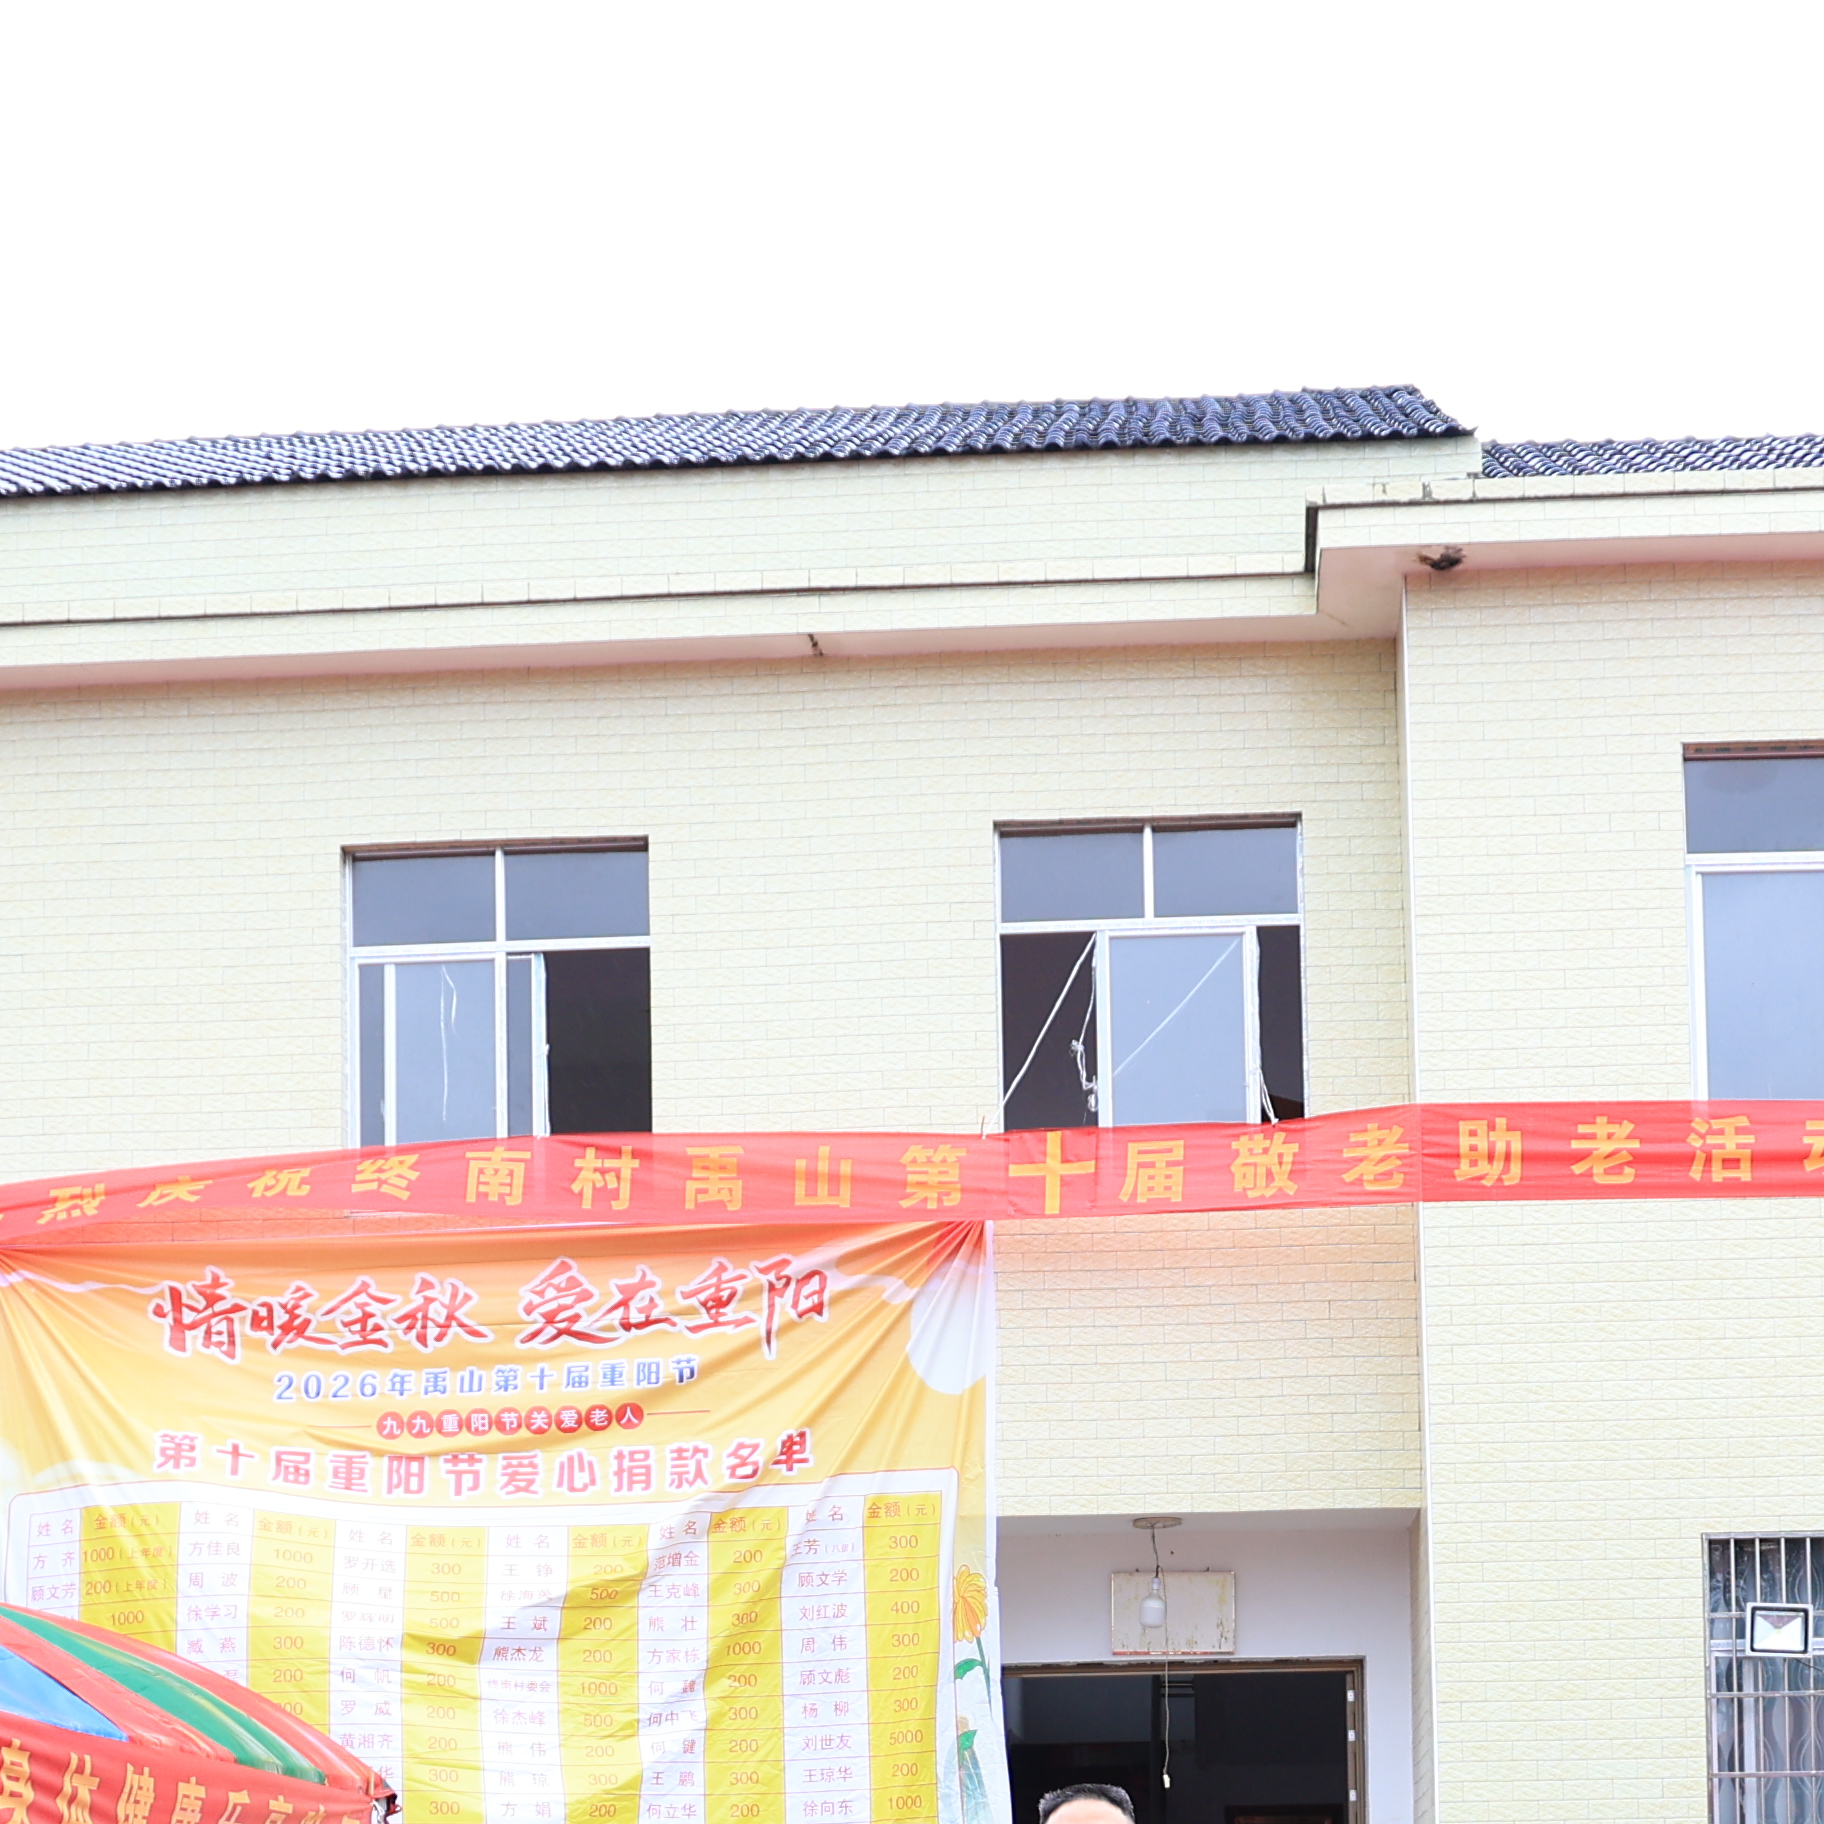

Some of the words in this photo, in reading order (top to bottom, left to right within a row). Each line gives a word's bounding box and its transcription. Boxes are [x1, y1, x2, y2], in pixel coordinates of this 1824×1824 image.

[152, 1272, 486, 1358] 情暖金秋
[519, 1259, 829, 1358] 爱在重阳
[276, 1356, 698, 1400] 2026年禹山第十届重阳节
[379, 1404, 642, 1438] 九九重阳节关爱老人
[155, 1430, 810, 1496] 第十届重阳节爱心捐款名单
[188, 1540, 240, 1557] 方佳良
[889, 1535, 918, 1549] 300
[273, 1548, 313, 1563] 1000
[733, 1550, 763, 1564] 200
[431, 1563, 461, 1575] 300
[594, 1564, 623, 1575] 200
[889, 1568, 919, 1582] 200
[275, 1576, 306, 1589] 200
[798, 1569, 847, 1587] 顾文学
[31, 1582, 76, 1602] 顾文芳
[590, 1588, 618, 1602] 500
[648, 1583, 700, 1599] 王克峰
[733, 1580, 761, 1595] 300
[430, 1591, 460, 1602] 500
[187, 1604, 237, 1622] 徐学习
[274, 1606, 305, 1618] 200
[799, 1602, 848, 1619] 刘红波
[890, 1600, 920, 1614] 400
[110, 1610, 145, 1626] 1000
[429, 1617, 459, 1629] 500
[582, 1617, 612, 1630] 200
[732, 1611, 758, 1625] 300
[273, 1636, 304, 1650] 300
[339, 1635, 395, 1652] 陈德怀
[892, 1633, 920, 1647] 300
[426, 1642, 457, 1656] 300
[583, 1649, 612, 1663] 200
[726, 1641, 761, 1656] 1000
[273, 1668, 304, 1683] 200
[427, 1672, 456, 1687] 200
[893, 1665, 918, 1680] 200
[726, 1674, 757, 1687] 200
[579, 1682, 618, 1697] 1000
[426, 1705, 456, 1720] 200
[894, 1697, 918, 1713] 300
[584, 1714, 613, 1728] 500
[728, 1706, 759, 1721] 300
[428, 1736, 458, 1752] 200
[802, 1733, 851, 1751] 刘世友
[889, 1729, 923, 1746] 5000
[585, 1745, 614, 1757] 200
[729, 1739, 758, 1753] 200
[429, 1769, 459, 1782] 300
[803, 1766, 853, 1783] 王琼华
[892, 1763, 918, 1777] 200
[588, 1774, 618, 1785] 300
[730, 1771, 759, 1786] 300
[429, 1801, 460, 1815] 300
[803, 1799, 854, 1817] 徐向东
[888, 1795, 922, 1810] 1000
[589, 1803, 617, 1818] 200
[646, 1803, 697, 1819] 何立华
[730, 1804, 760, 1817] 200
